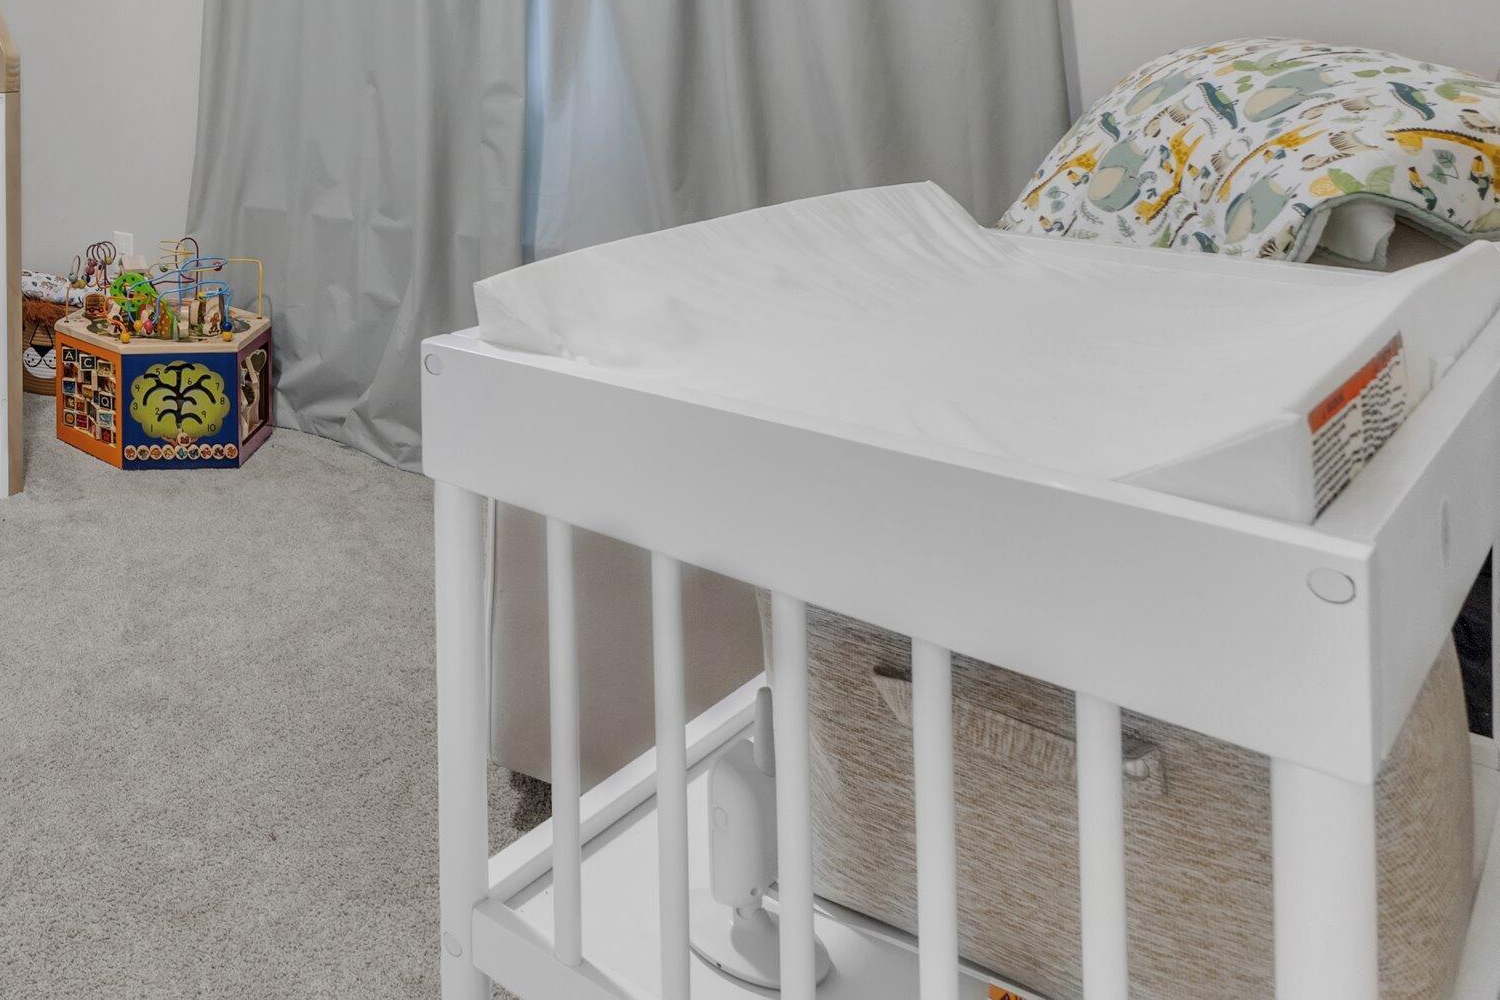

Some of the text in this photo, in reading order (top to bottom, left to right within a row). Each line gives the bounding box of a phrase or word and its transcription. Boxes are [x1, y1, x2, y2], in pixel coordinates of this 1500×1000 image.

[65, 351, 74, 361] A
[83, 358, 93, 368] C
[101, 397, 110, 408] Q
[207, 424, 217, 432] 10
